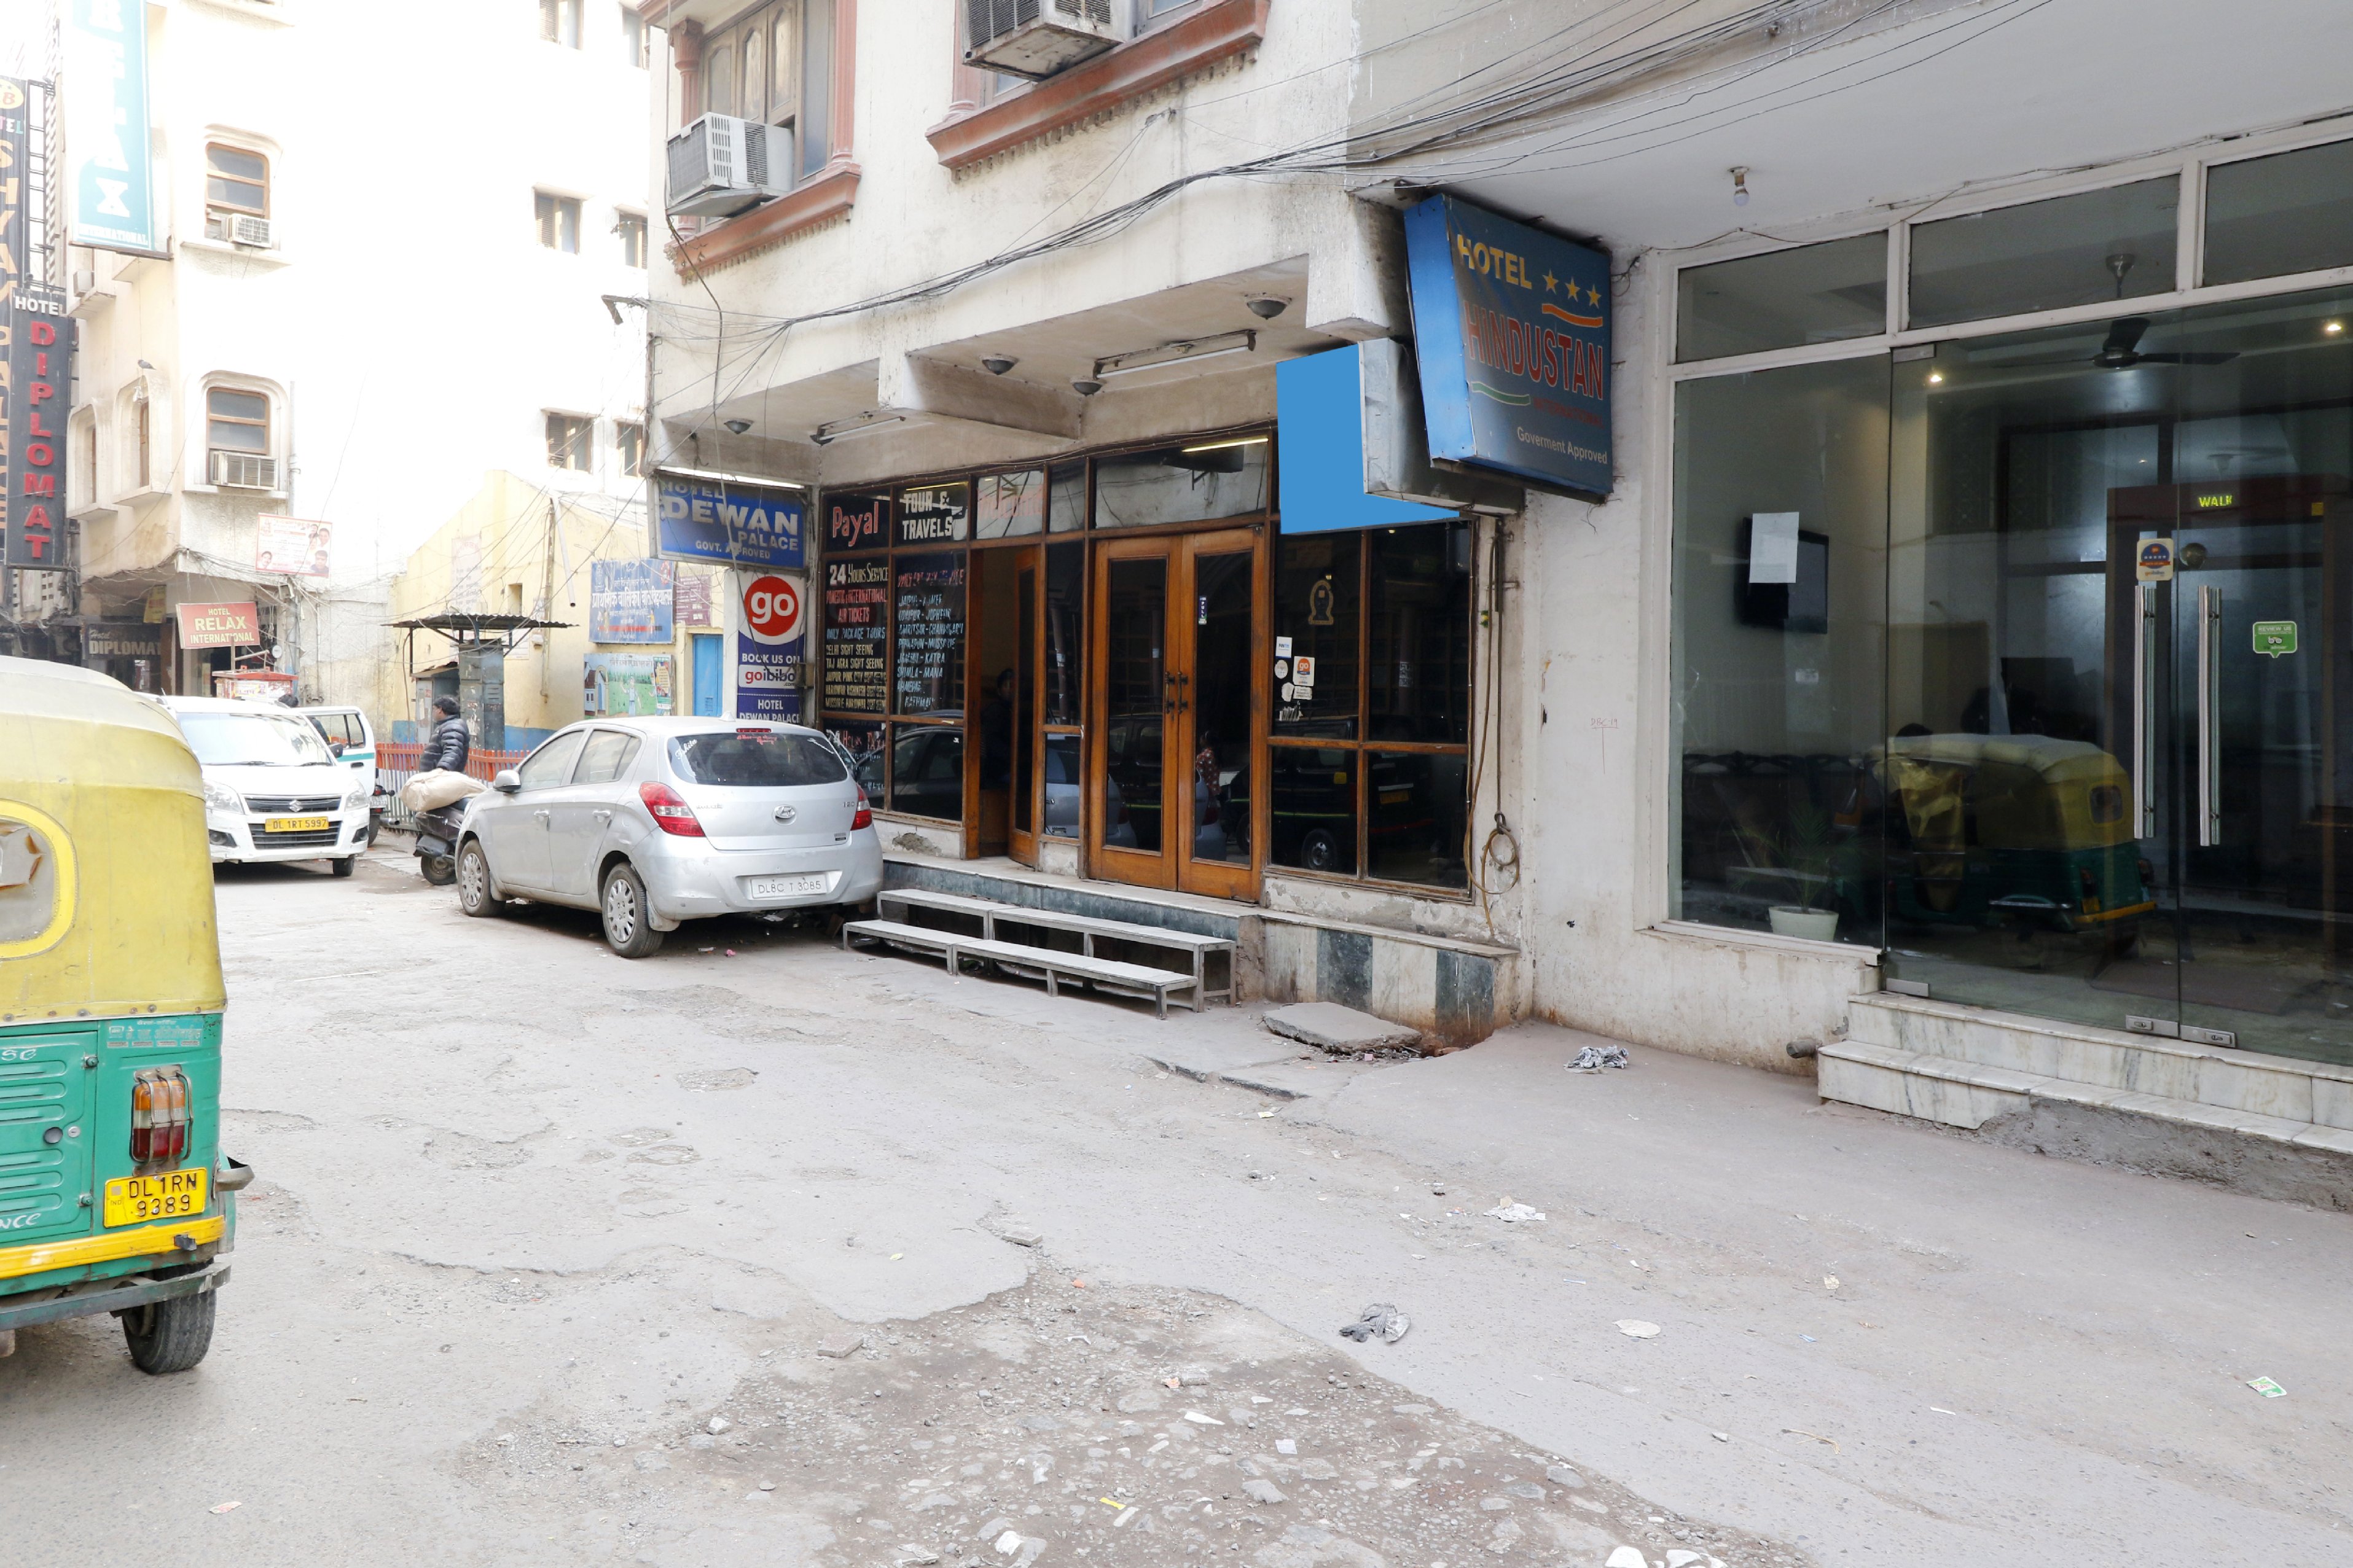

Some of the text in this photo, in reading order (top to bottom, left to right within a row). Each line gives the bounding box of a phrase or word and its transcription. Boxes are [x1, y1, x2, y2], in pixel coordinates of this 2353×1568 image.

[1457, 234, 1532, 289] HOTEL
[1464, 300, 1603, 400] HINDUSTAN
[24, 321, 56, 558] DIPLOMAT
[1517, 427, 1607, 464] Goverment Approved
[903, 491, 933, 514] TOUR
[664, 496, 798, 536] DEWAN
[832, 501, 879, 547] Payal
[902, 516, 952, 540] TRAVELS
[738, 531, 798, 551] PALACE
[695, 540, 770, 560] GOVT. APROVED
[829, 564, 847, 586] 24
[751, 591, 795, 625] go
[838, 607, 870, 623] AIR TICKETS
[194, 615, 247, 631] RELAX
[867, 627, 885, 639] TOURS
[840, 644, 853, 655] SIGHT
[856, 644, 874, 655] SEEING
[742, 653, 800, 665] BOOK US ON
[826, 658, 883, 669] TAJ AGRA SIGHT SEEING
[925, 653, 946, 664] KATRA
[1299, 662, 1309, 671] go
[745, 668, 796, 684] goibibo
[897, 666, 918, 678] SHIMLA
[758, 699, 784, 711] HOTEL
[739, 712, 770, 721] DEWAN
[305, 819, 326, 828] 5997
[797, 880, 821, 891] 3085
[136, 1194, 190, 1217] 9389
